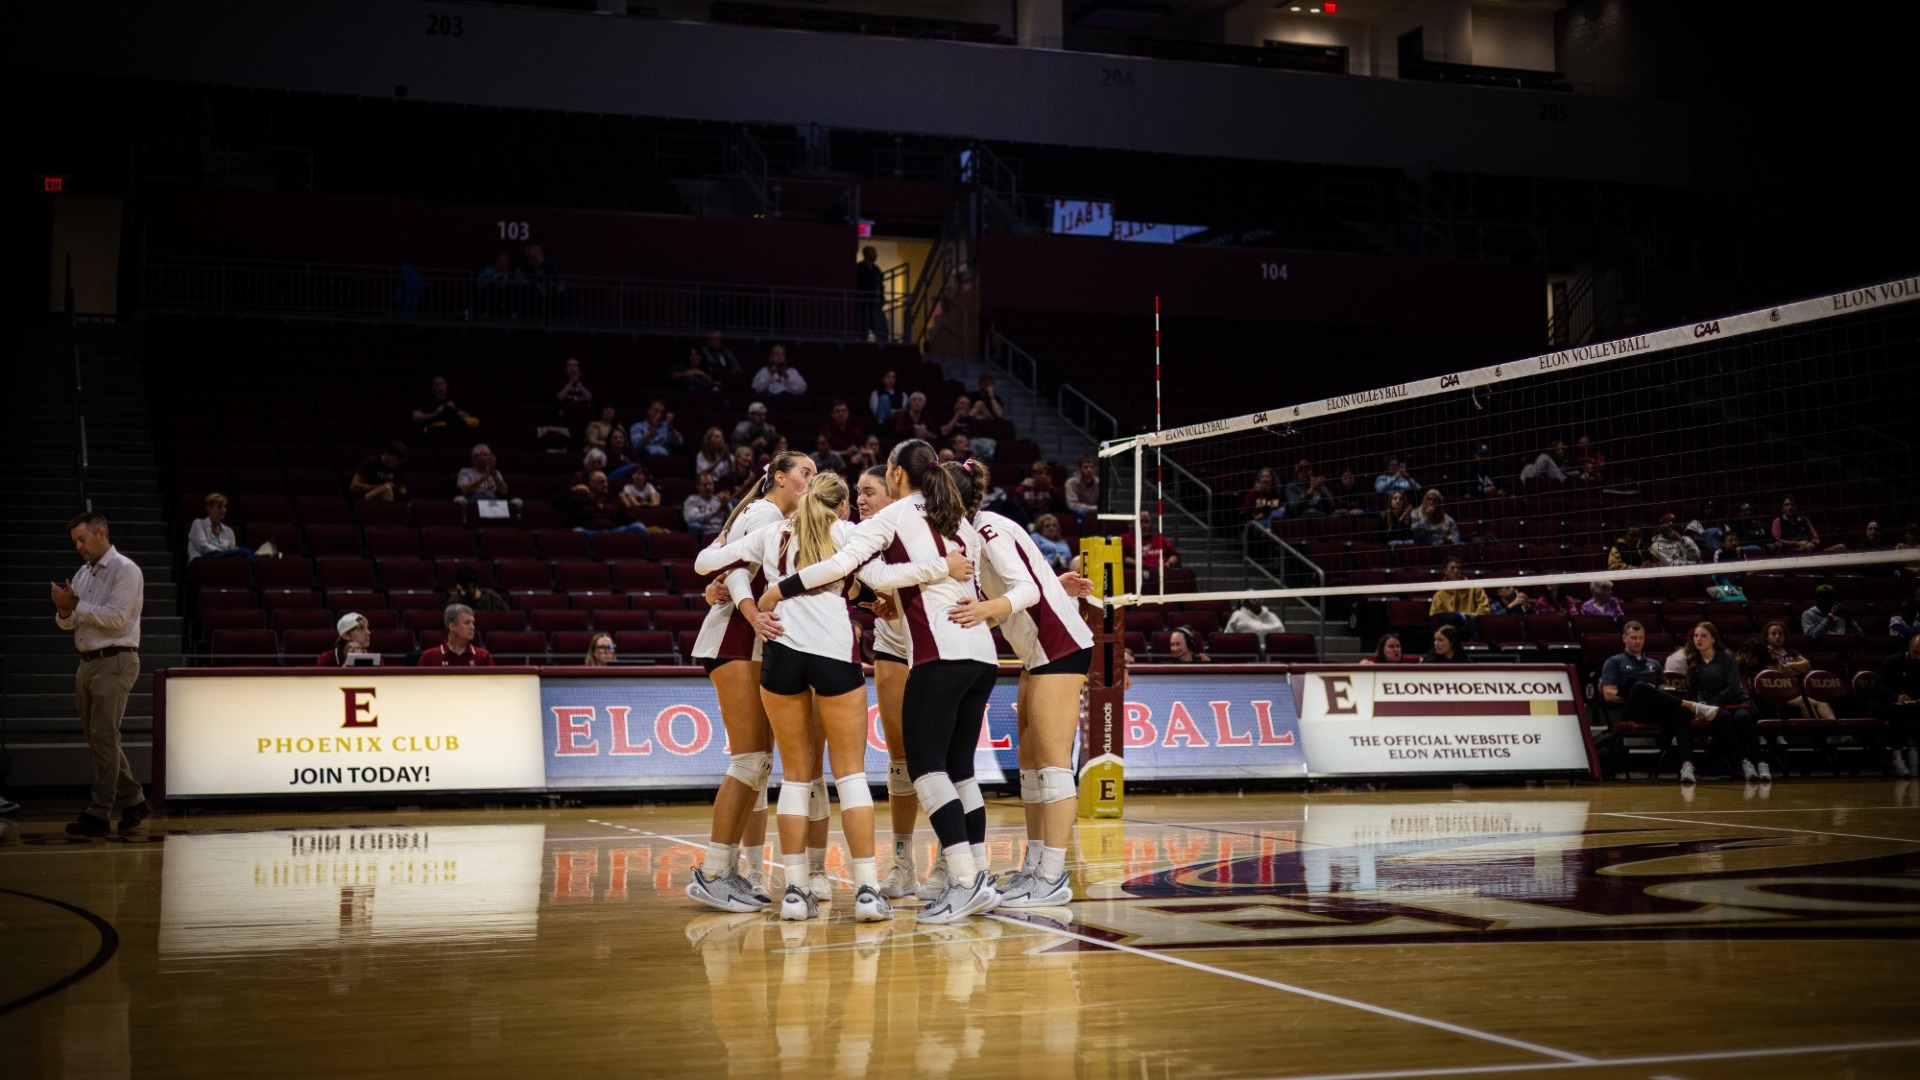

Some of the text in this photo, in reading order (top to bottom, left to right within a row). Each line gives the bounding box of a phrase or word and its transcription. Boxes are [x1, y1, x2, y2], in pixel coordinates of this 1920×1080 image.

[427, 14, 463, 36] 203
[1540, 102, 1567, 121] 205
[44, 177, 63, 191] EXIT
[496, 220, 531, 241] 103
[1261, 262, 1289, 282] 104
[1833, 281, 1877, 310] ELON
[1694, 321, 1721, 339] CAA
[1539, 335, 1650, 370] ELON VOLLEYBALL
[1440, 374, 1460, 389] CAA
[1327, 384, 1409, 411] ELON VOLLEYBALL
[1252, 412, 1268, 425] CAA
[978, 523, 999, 544] E
[1382, 682, 1564, 695] ELONPHOENIX.COM
[1760, 677, 1793, 689] ELON
[1810, 679, 1841, 689] ELON
[1321, 675, 1358, 715] E
[339, 687, 378, 728] E
[551, 703, 732, 756] ELO
[1102, 702, 1113, 770] sports impts
[257, 735, 460, 754] PHOENIX CLUB
[1350, 734, 1542, 747] THE OFFICIAL WEBSITE OF
[1389, 748, 1511, 759] ELON ATHLETICS
[290, 765, 430, 784] JOIN TODAY!
[1099, 779, 1116, 801] E
